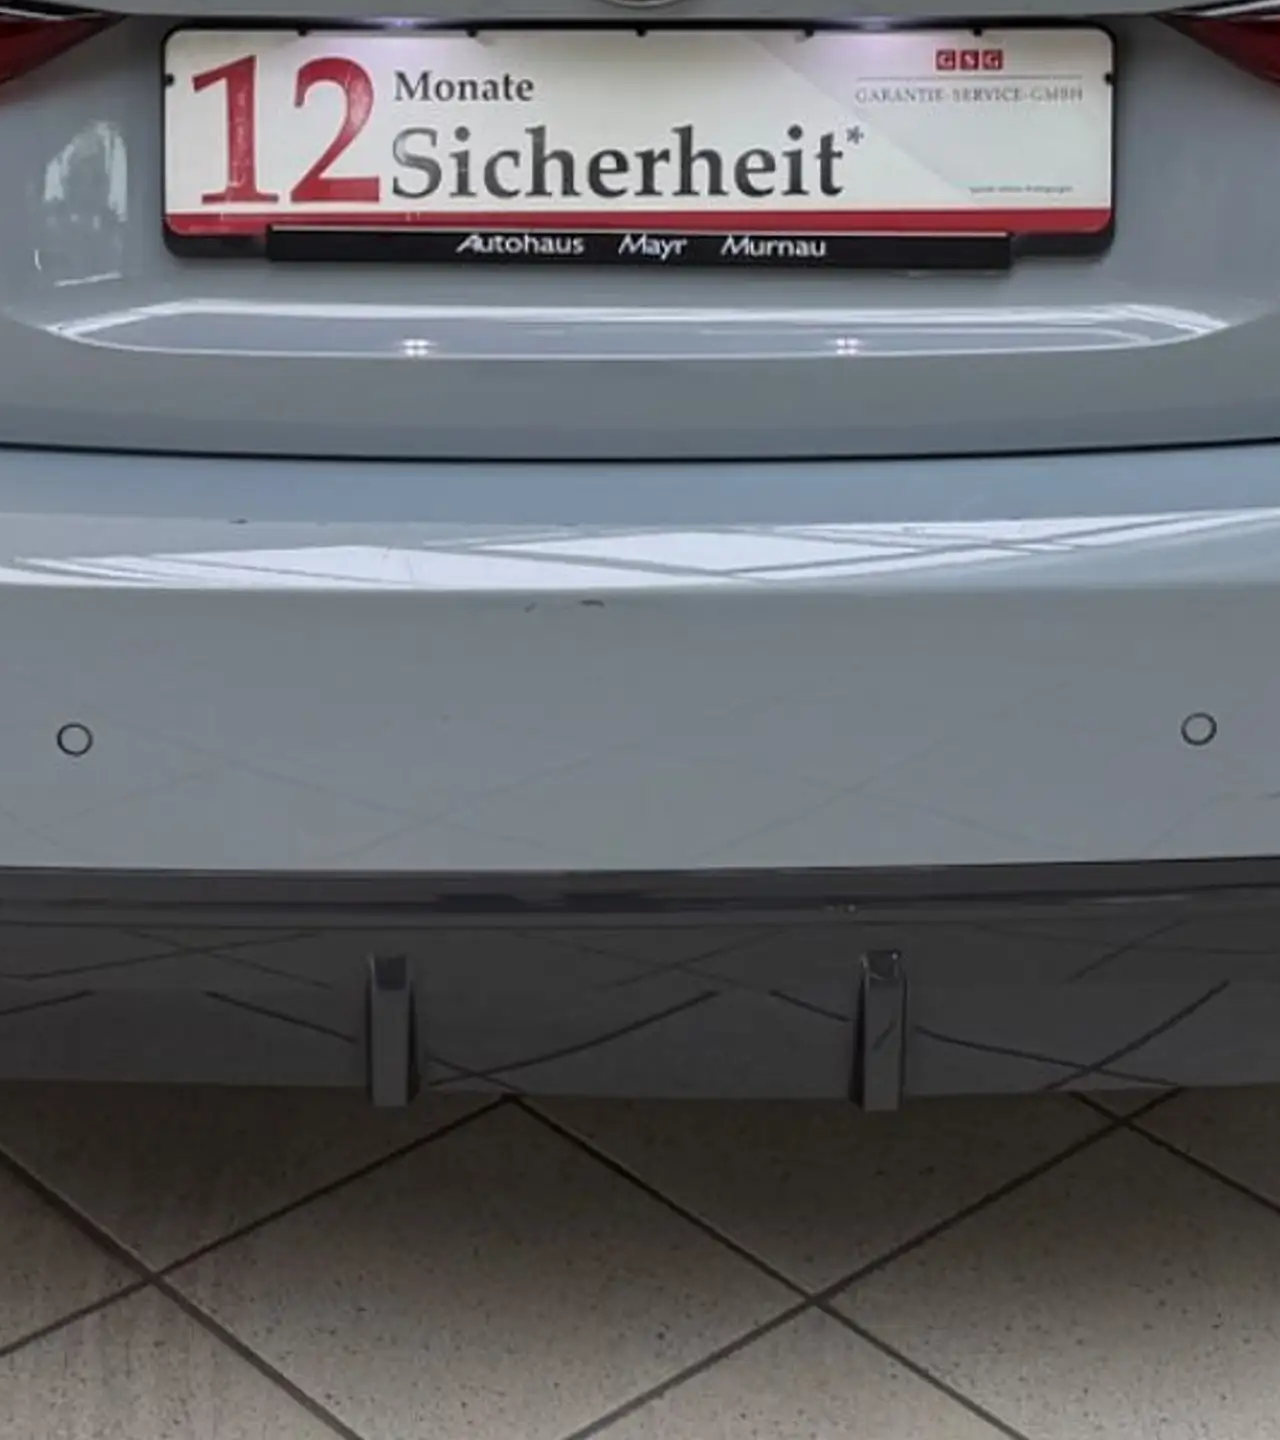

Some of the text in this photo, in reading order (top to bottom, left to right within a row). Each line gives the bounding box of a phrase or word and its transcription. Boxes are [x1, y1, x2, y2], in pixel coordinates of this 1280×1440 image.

[394, 70, 534, 101] Monate
[192, 54, 380, 203] 12
[456, 233, 827, 260] Autohaus Mayr Murnau
